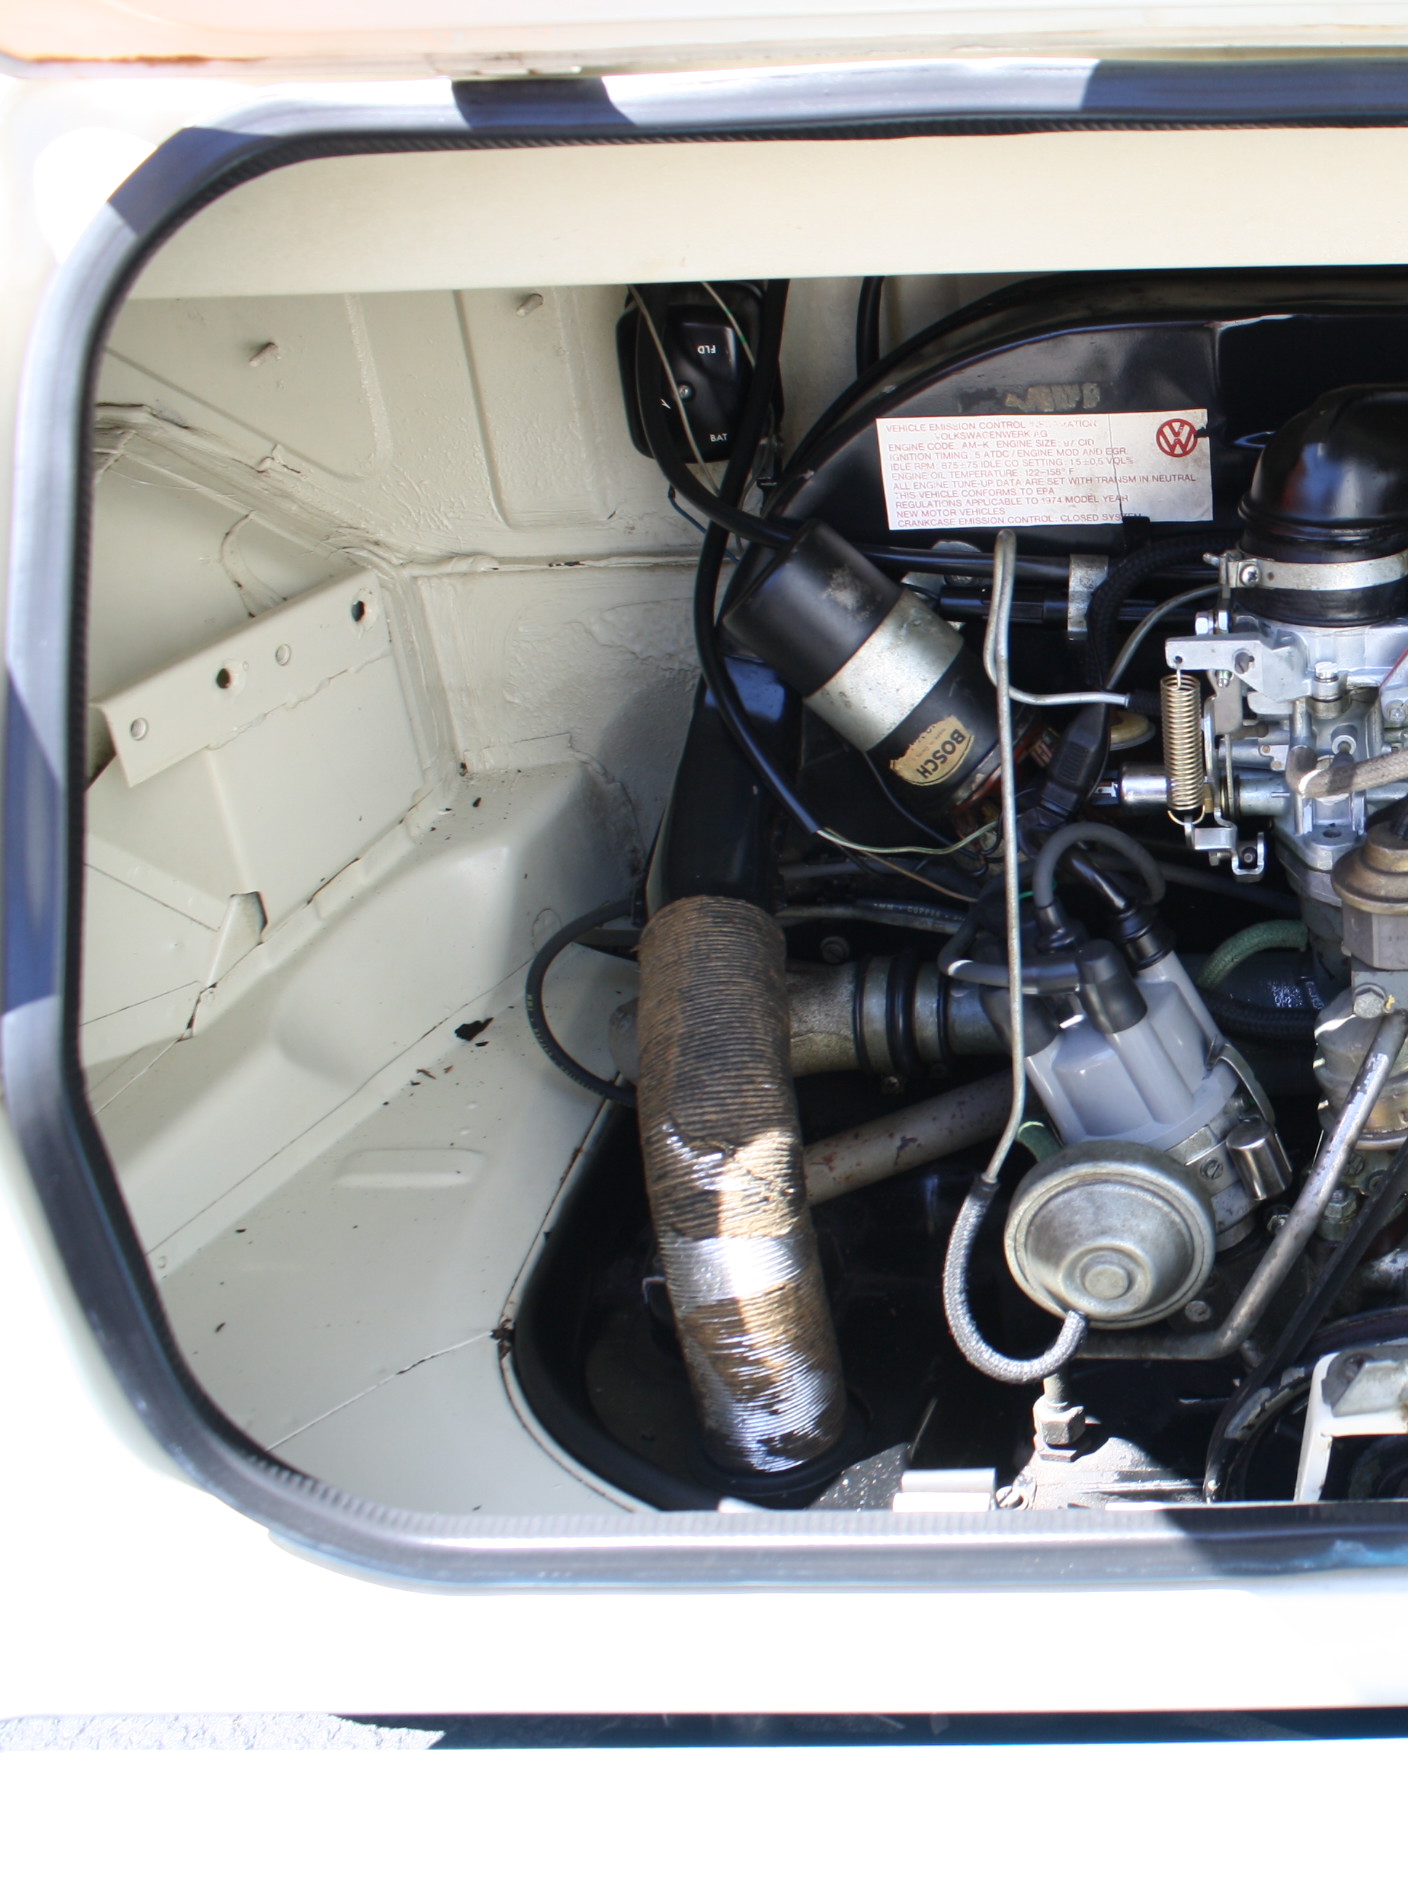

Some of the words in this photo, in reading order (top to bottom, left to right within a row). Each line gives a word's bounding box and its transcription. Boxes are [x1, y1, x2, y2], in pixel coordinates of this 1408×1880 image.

[697, 345, 717, 354] FLD
[886, 423, 928, 433] VEHICLE
[929, 422, 976, 431] EMISSION
[979, 420, 1026, 430] CONTROL
[710, 433, 728, 442] BAT
[1034, 429, 1048, 438] AG
[888, 443, 925, 452] ENGINE
[996, 440, 1032, 448] ENGINE
[889, 452, 932, 462] IGNITION
[984, 449, 1009, 458] ATDC
[1017, 448, 1053, 458] ENGINE
[1057, 448, 1080, 457] MOD
[1083, 448, 1103, 456] AND
[891, 462, 912, 471] IDLE
[981, 460, 1002, 468] IDLE
[1004, 460, 1019, 468] CO
[892, 472, 928, 481] ENGINE
[931, 471, 947, 480] OIL
[893, 482, 911, 491] ALL
[913, 481, 949, 490] ENGINE
[952, 479, 993, 489] TUNE-UP
[996, 478, 1022, 488] DATA
[1025, 477, 1045, 486] ARE
[1048, 477, 1066, 485] SET
[1069, 476, 1093, 485] WITH
[1140, 474, 1149, 483] IN
[1152, 473, 1197, 483] NEUTRAL
[919, 489, 959, 499] VEHICLE
[961, 488, 1017, 497] CONFORMS
[1020, 488, 1033, 496] TO
[1036, 487, 1055, 495] EPA
[896, 500, 962, 509] REGULATIONS
[966, 497, 1023, 507] APPLICABLE
[1026, 497, 1039, 505] TO
[1065, 495, 1099, 504] MODEL
[1103, 494, 1129, 503] YEAR
[897, 511, 918, 519] NEW
[921, 508, 957, 518] MOTOR
[959, 507, 1006, 516] VEHICLES
[897, 519, 956, 528] CRANKCASE
[959, 517, 1005, 526] EMISSION
[1060, 513, 1099, 522] CLOSED
[916, 729, 966, 779] BOSCH
